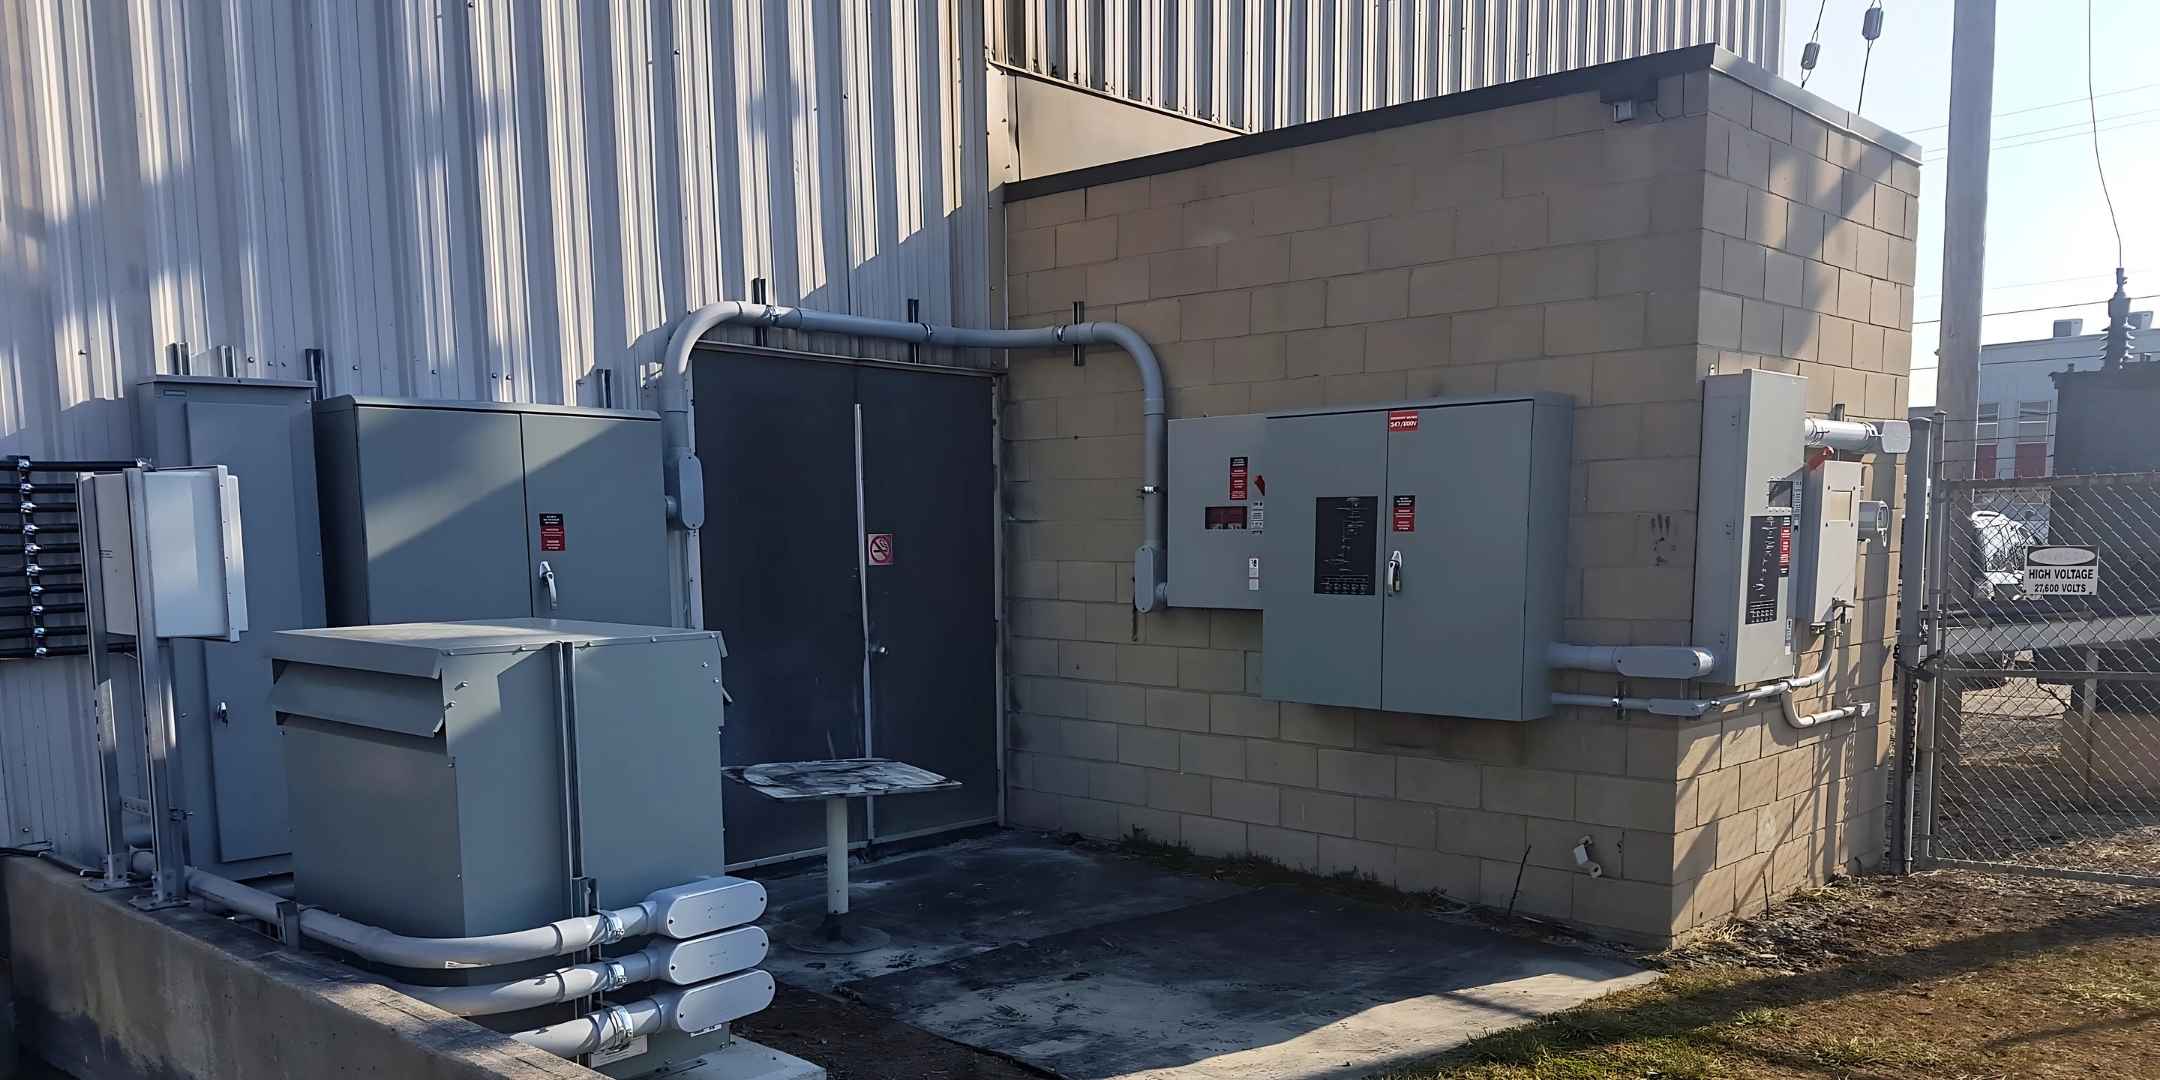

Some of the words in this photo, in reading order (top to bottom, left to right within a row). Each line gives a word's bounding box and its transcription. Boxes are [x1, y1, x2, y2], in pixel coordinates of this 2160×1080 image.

[2029, 569, 2051, 579] HIGH
[2054, 568, 2094, 580] VOLTAGE
[2034, 584, 2060, 593] 27,600
[2062, 584, 2086, 593] VOLTS
